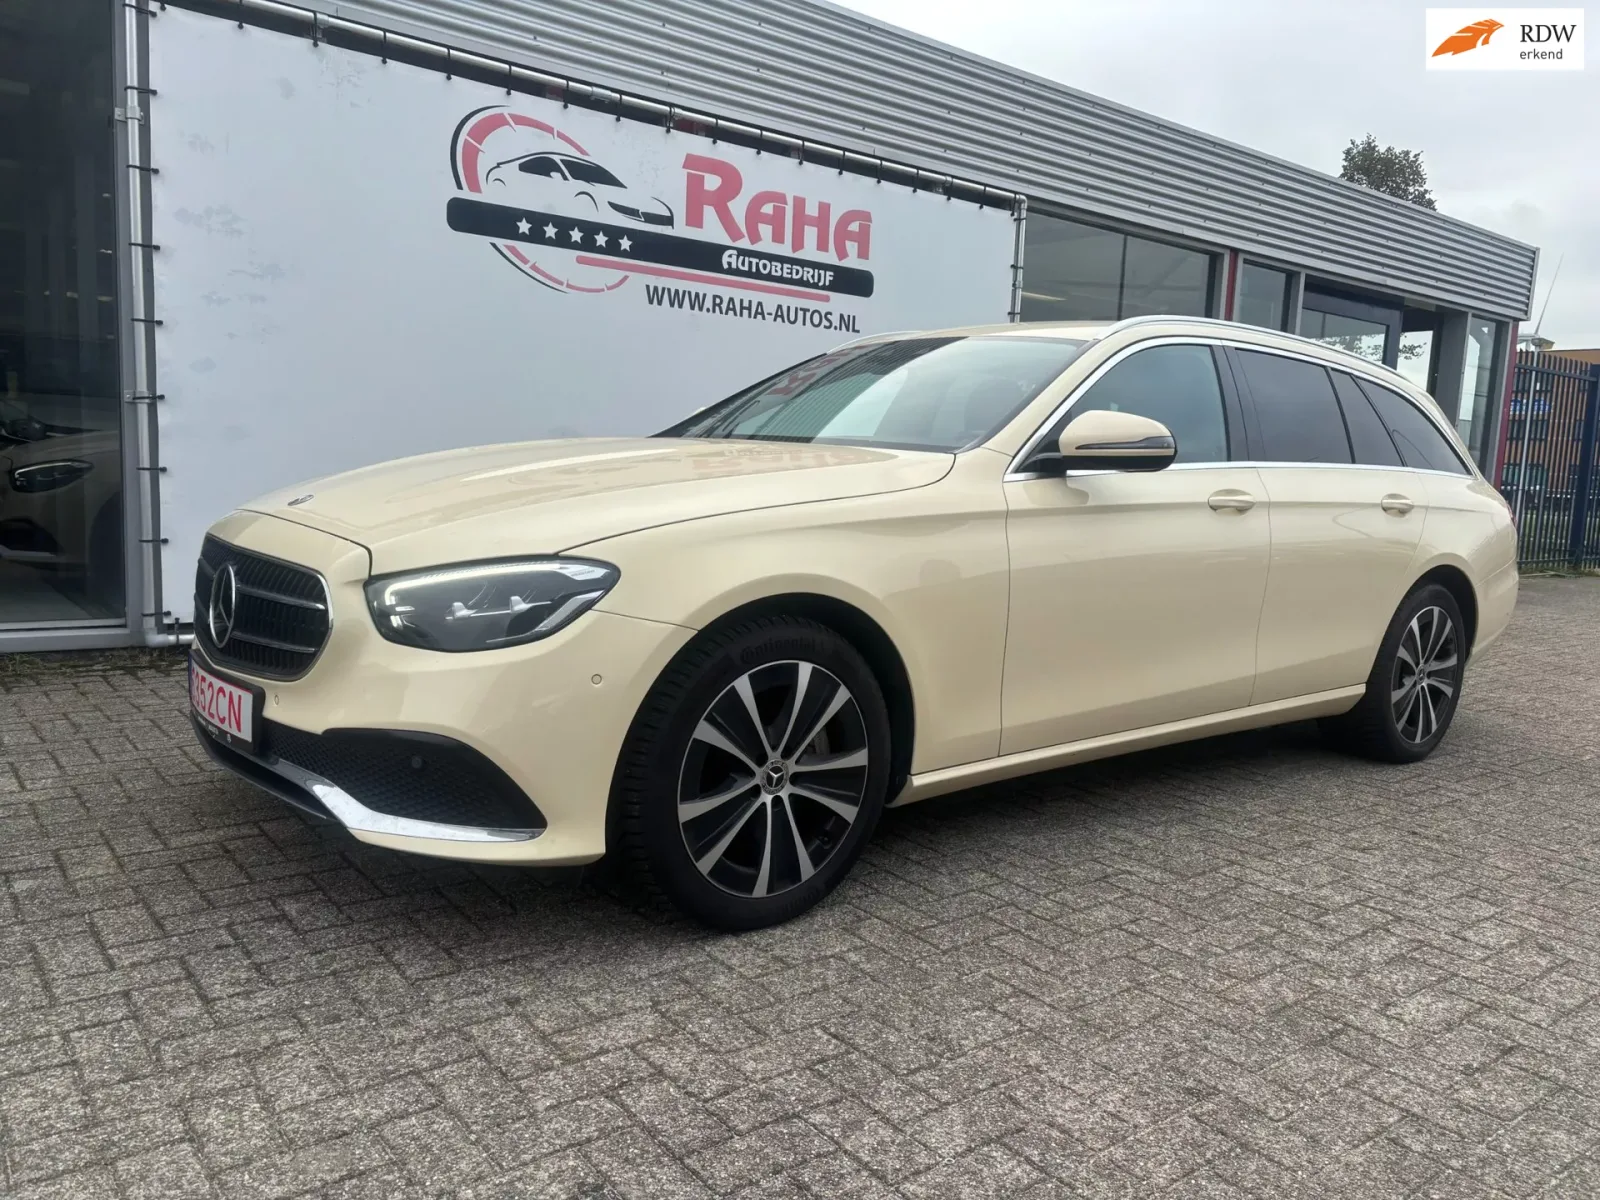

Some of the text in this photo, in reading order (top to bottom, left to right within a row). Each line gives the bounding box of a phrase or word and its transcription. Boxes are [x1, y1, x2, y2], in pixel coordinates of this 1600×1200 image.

[682, 153, 873, 262] RAHA
[722, 249, 834, 287] AUTOBEDRIJF
[645, 284, 861, 334] WWW.RAHA-AUTOS.NL
